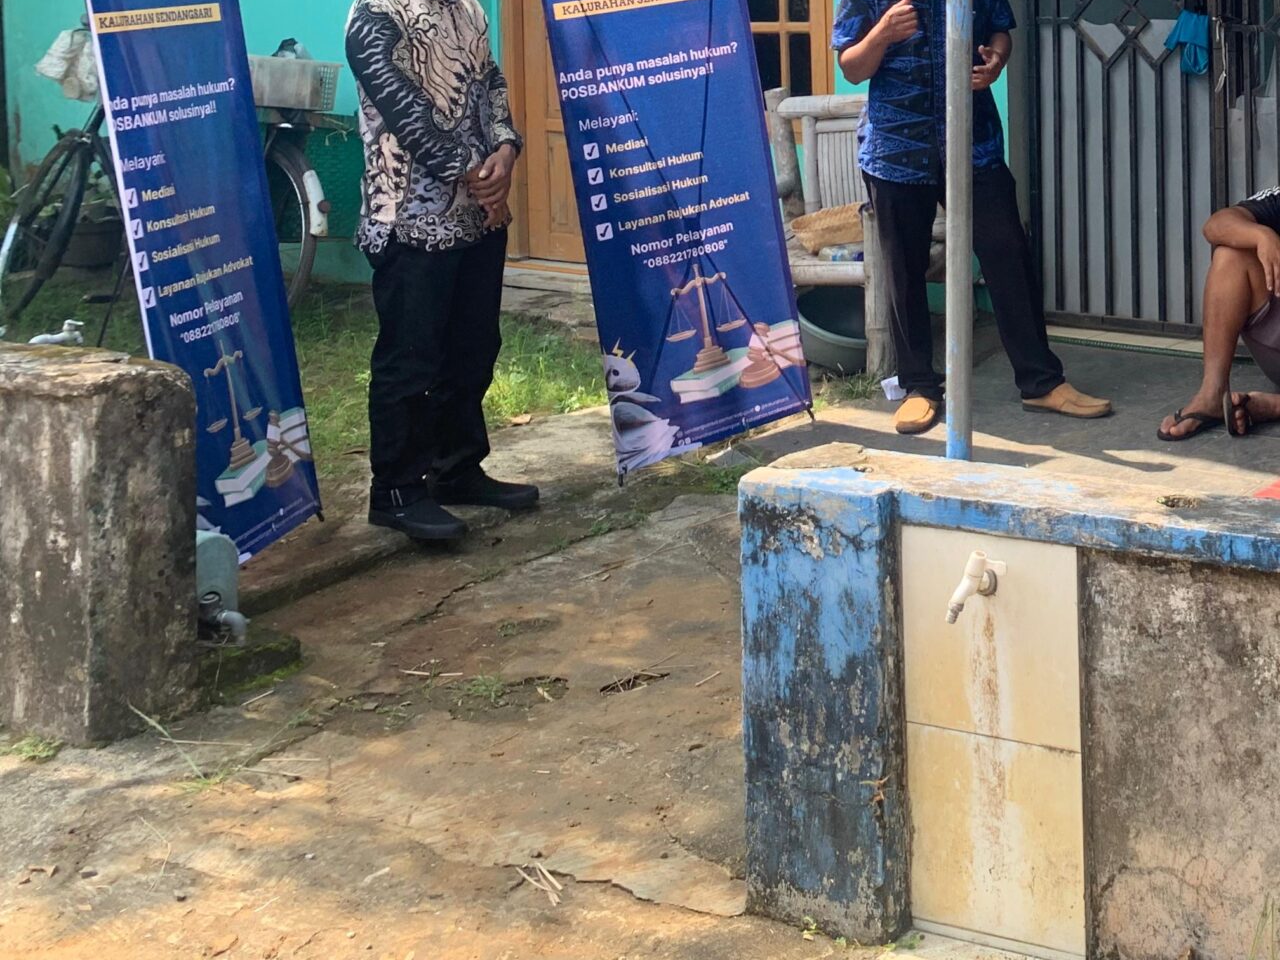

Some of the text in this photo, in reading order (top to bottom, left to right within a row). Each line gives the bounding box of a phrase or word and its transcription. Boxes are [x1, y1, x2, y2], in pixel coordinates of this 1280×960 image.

[98, 7, 213, 29] KALURAHAN SENDANGSARI
[559, 41, 738, 84] Anda punya masalah hukum?
[131, 92, 158, 111] punya
[160, 84, 197, 103] masalah
[197, 78, 235, 96] hukum?
[561, 62, 714, 101] POSBANKUM solusinya!!
[168, 100, 217, 121] solusinya!!
[578, 110, 639, 132] Melayani:
[605, 136, 649, 154] Mediasi
[609, 150, 704, 179] Konsultasi Hukum
[141, 183, 176, 202] Mediasi
[613, 174, 708, 203] Sosialisasi Hukum
[189, 205, 215, 219] Hukum
[618, 190, 750, 231] Layanan Rujukan Advokat
[194, 234, 220, 249] Hukum
[631, 221, 735, 256] Nomor Pelayanan
[158, 277, 196, 297] Layanan
[222, 255, 254, 274] Advokat
[169, 291, 243, 327] Nomor Pelayanan
